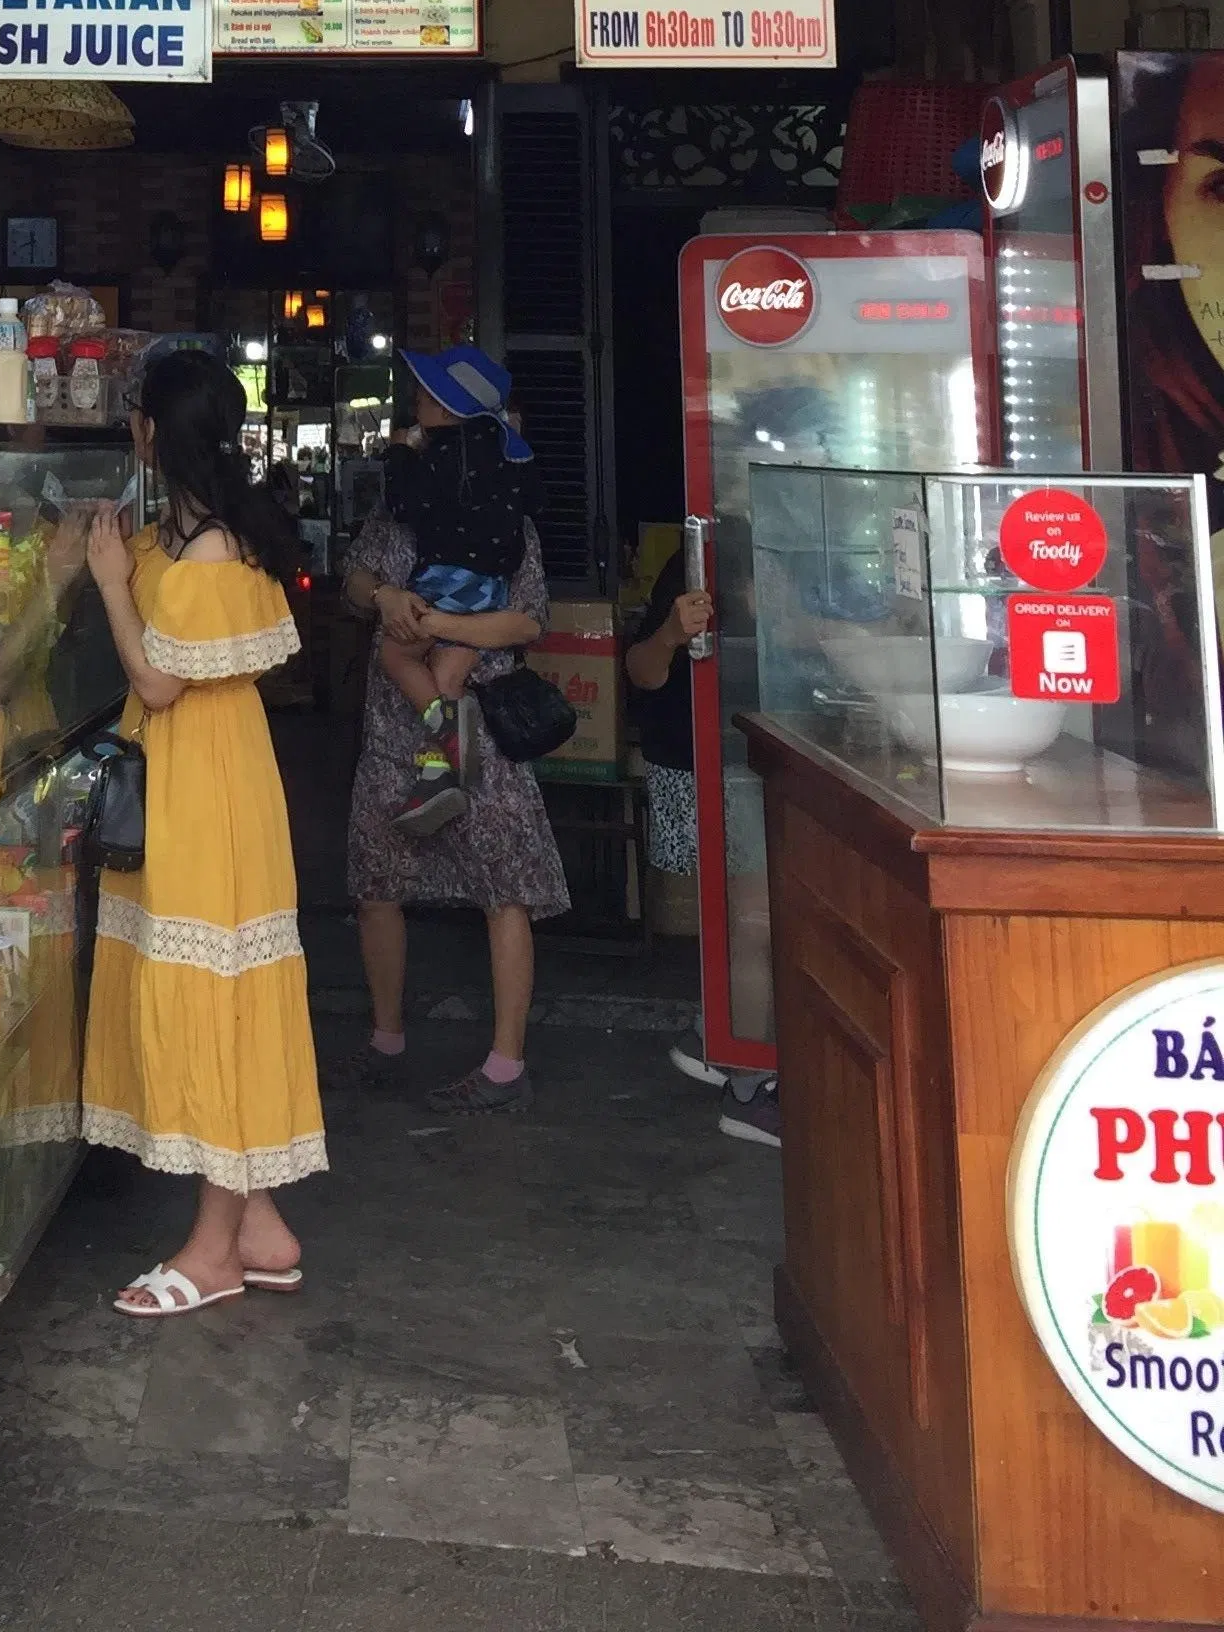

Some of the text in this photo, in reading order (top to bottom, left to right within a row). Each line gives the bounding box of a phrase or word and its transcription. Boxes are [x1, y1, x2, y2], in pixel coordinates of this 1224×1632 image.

[63, 24, 185, 66] JUICE
[590, 10, 822, 53] FROM 6h30am TO 9h30pm
[720, 279, 808, 313] Coca-Cola
[1025, 511, 1081, 523] Review us
[1046, 527, 1062, 537] on
[1029, 539, 1084, 567] Foody
[1014, 602, 1112, 617] ORDER DELIVERY
[1039, 671, 1094, 695] Now
[1090, 1106, 1224, 1187] PH
